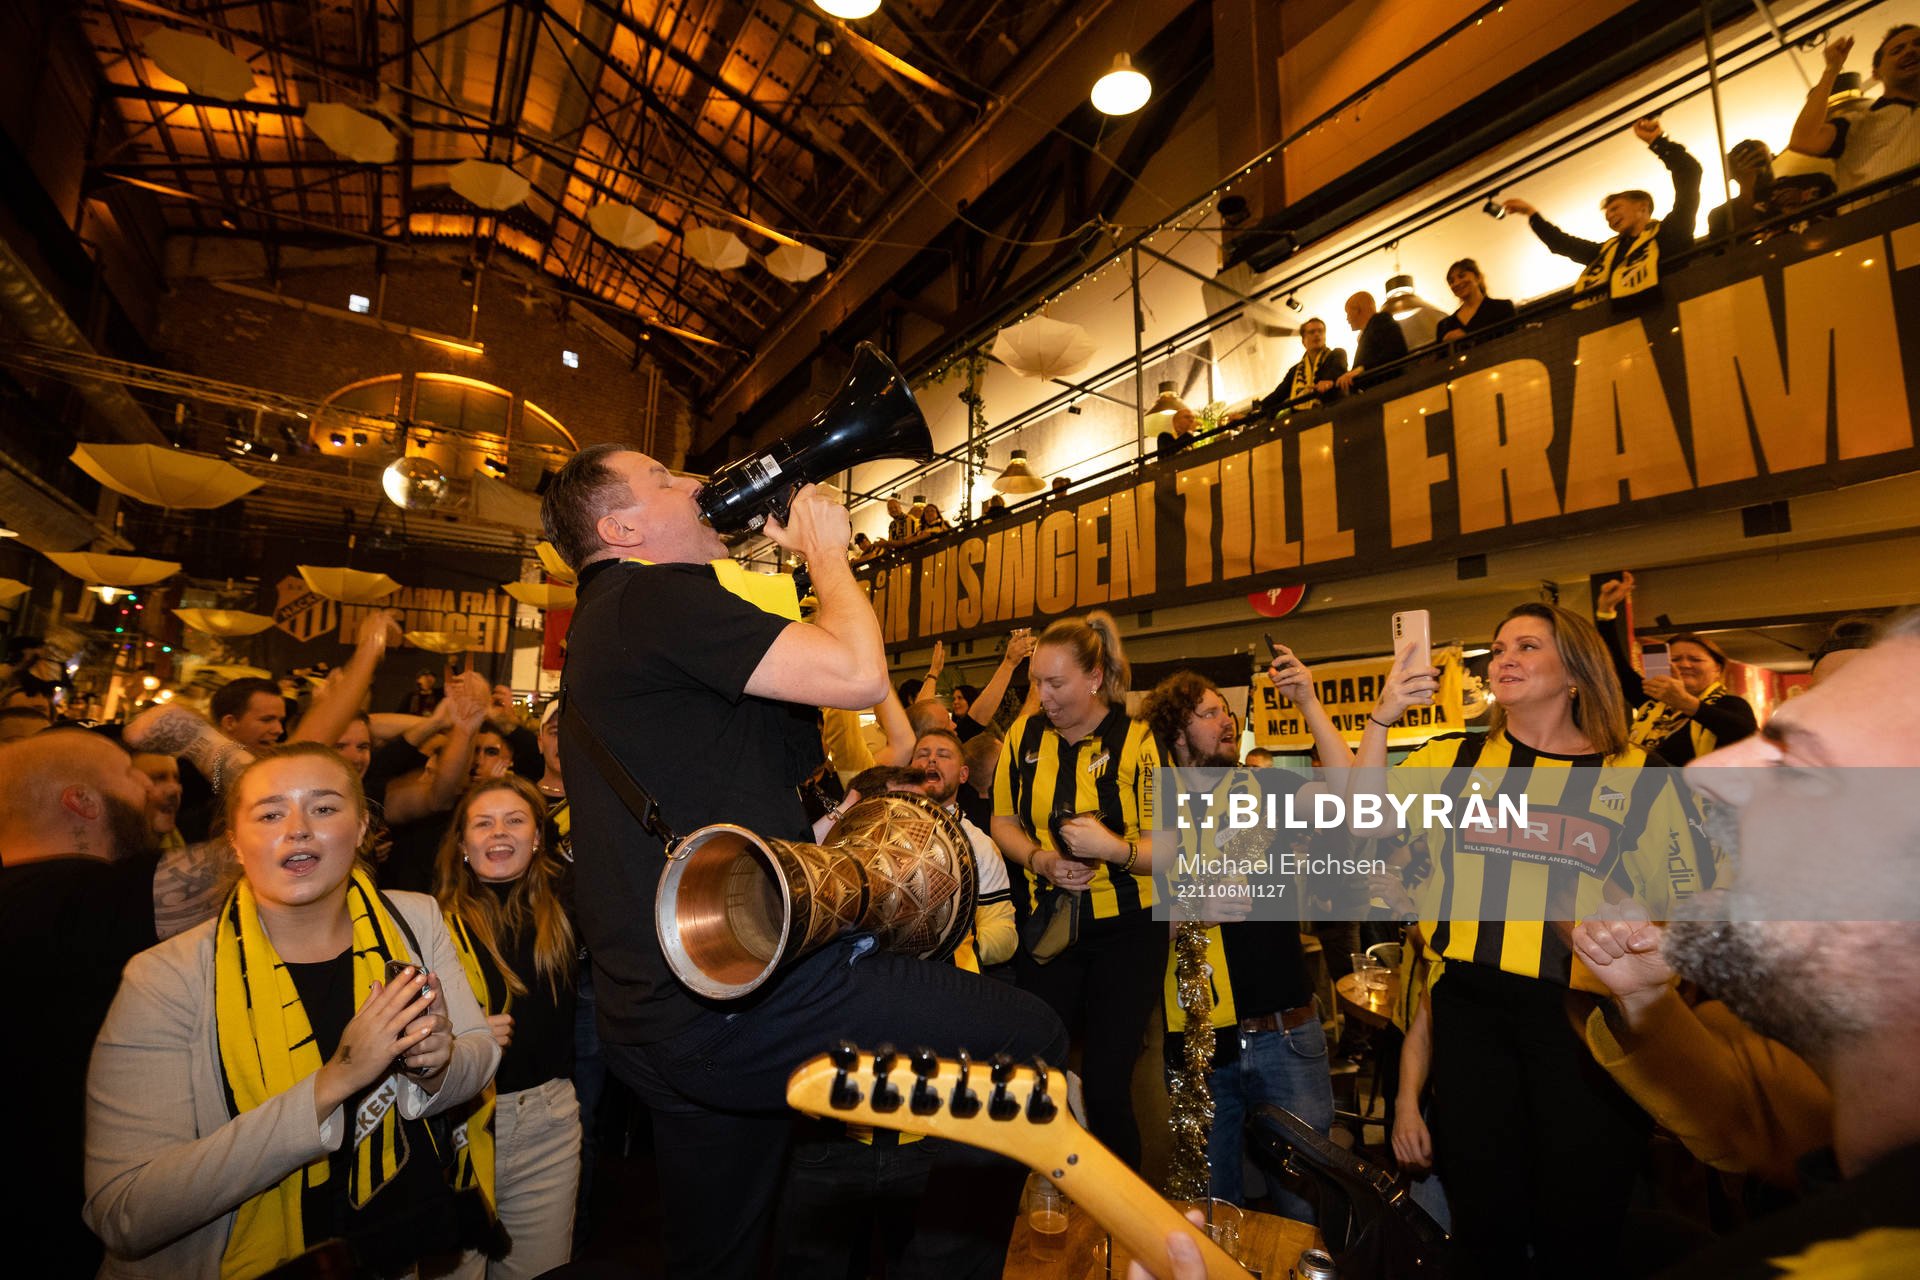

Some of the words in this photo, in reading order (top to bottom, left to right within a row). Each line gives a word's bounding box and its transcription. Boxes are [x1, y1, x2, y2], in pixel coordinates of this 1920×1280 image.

[857, 562, 912, 643] ÅN
[918, 481, 1156, 637] HISINGEN
[1176, 422, 1355, 587] TILL
[1268, 719, 1298, 736] MED
[1512, 850, 1547, 862] RIEMER
